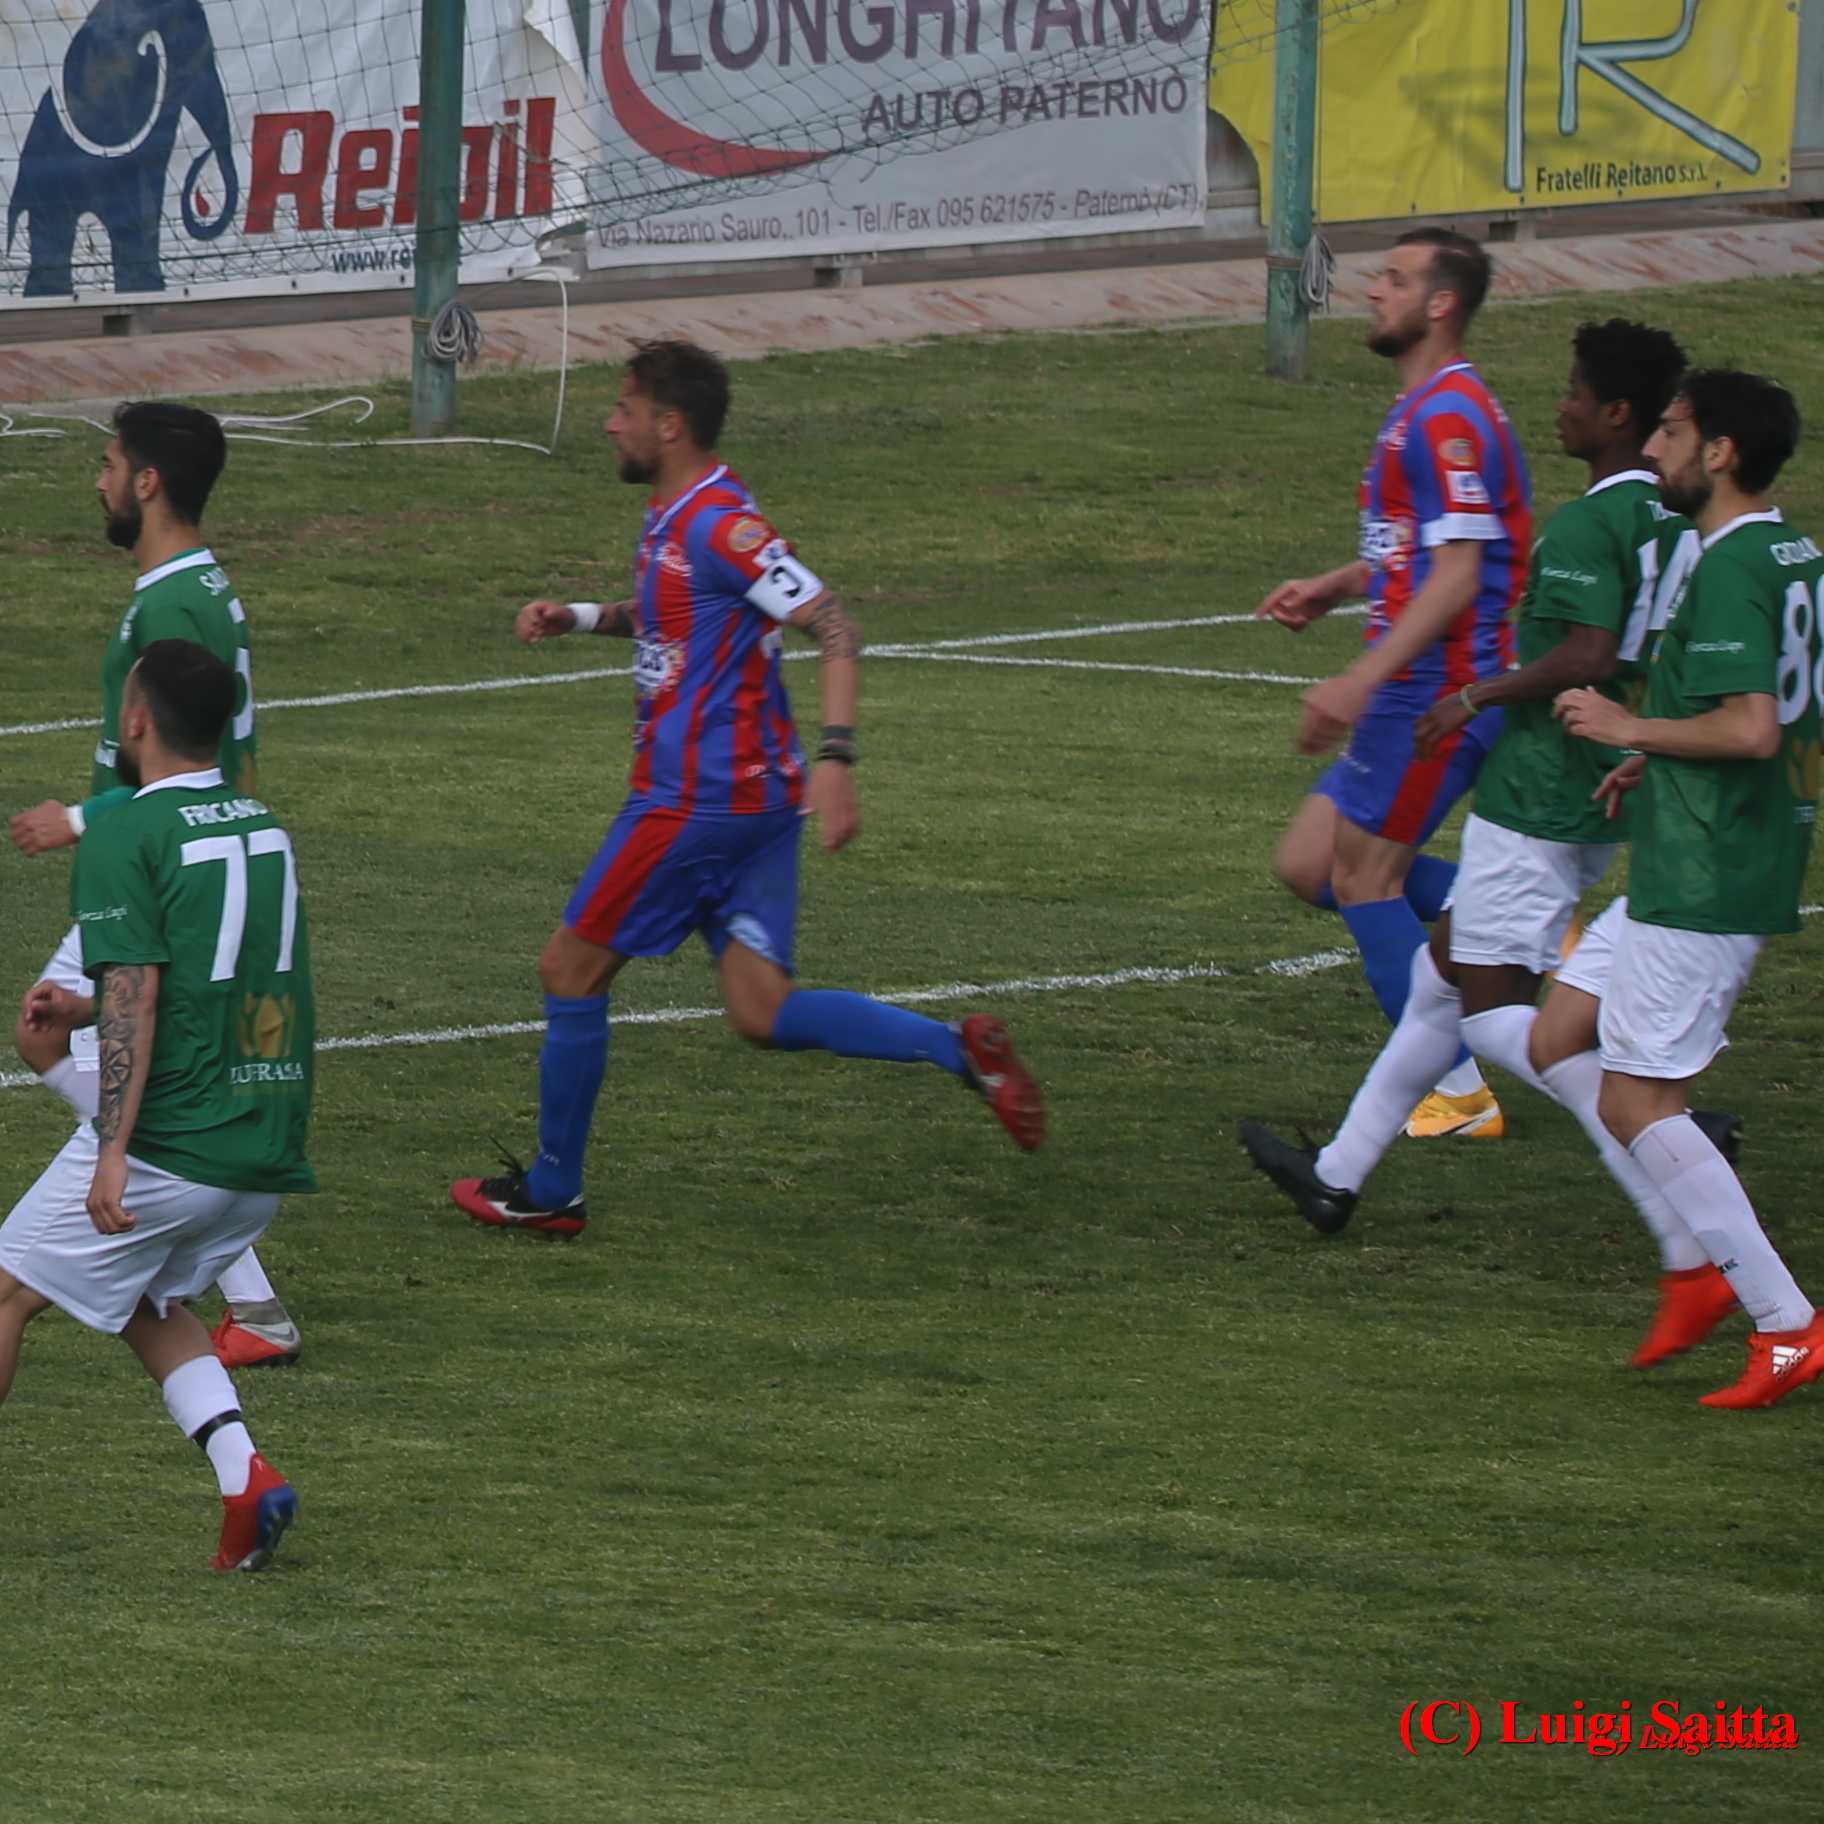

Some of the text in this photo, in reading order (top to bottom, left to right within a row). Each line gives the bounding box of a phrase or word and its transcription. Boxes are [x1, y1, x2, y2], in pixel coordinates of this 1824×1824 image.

[859, 64, 1189, 133] AUTO PATERNÒ
[1536, 163, 1601, 193] Fratelli
[1606, 161, 1676, 189] Reitano
[797, 207, 830, 237] 101
[936, 197, 975, 229] 095
[979, 191, 1056, 224] 621575
[180, 827, 298, 982] 77
